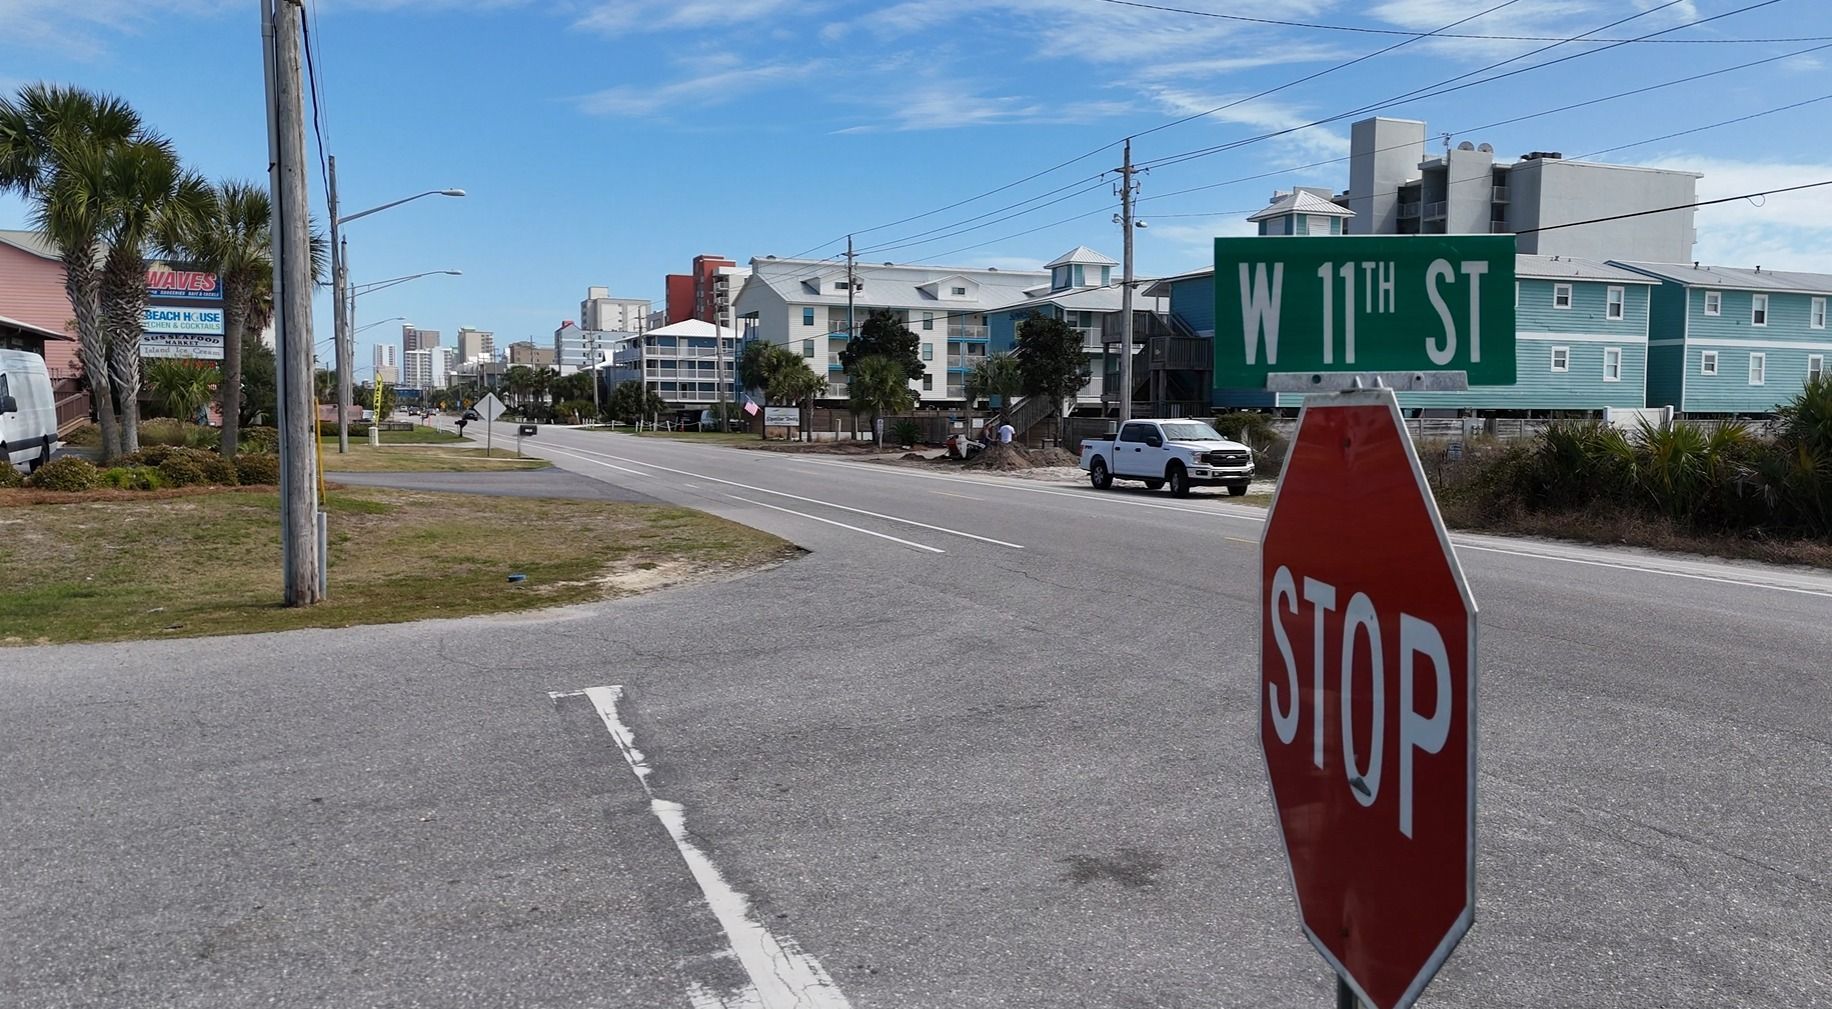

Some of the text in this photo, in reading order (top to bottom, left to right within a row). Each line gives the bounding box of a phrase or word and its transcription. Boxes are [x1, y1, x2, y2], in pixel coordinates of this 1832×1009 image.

[146, 271, 217, 291] WAVES
[145, 310, 220, 322] BEACH HOUSE
[1238, 258, 1488, 366] W 11TH ST
[168, 334, 220, 344] SEAFOOD
[193, 347, 220, 356] Cream
[1269, 565, 1452, 840] STOP
